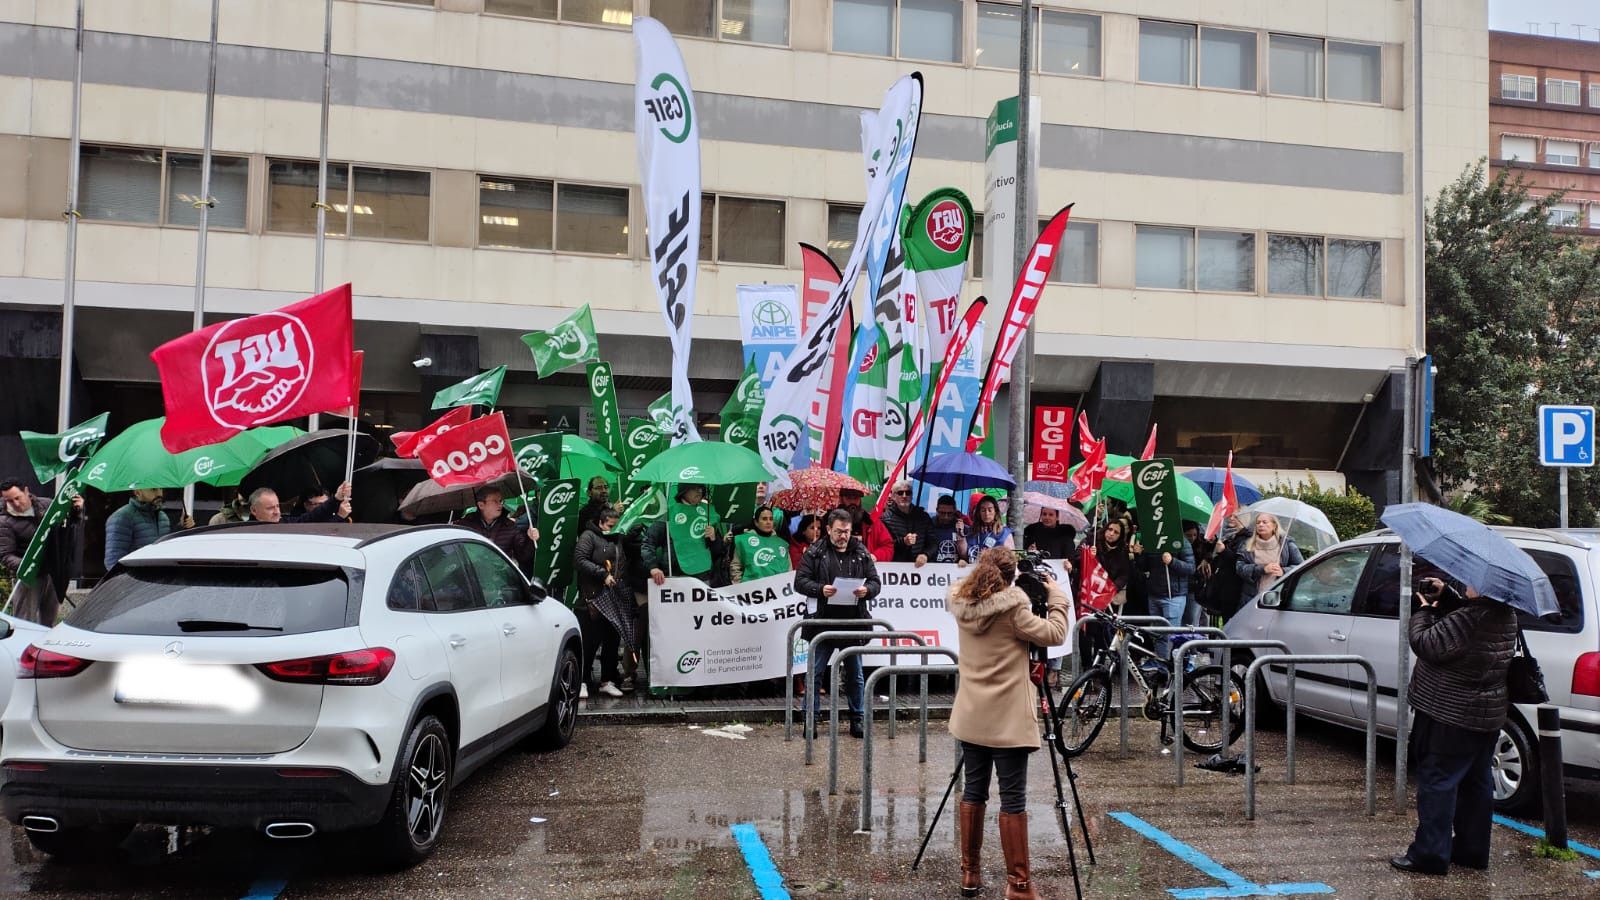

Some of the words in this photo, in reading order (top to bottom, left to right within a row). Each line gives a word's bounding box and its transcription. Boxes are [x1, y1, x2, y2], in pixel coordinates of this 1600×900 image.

[751, 325, 797, 338] ANPE
[852, 408, 882, 439] GT
[635, 431, 659, 443] CSIF
[1041, 410, 1065, 460] UGT
[1552, 412, 1586, 460] P
[519, 454, 549, 470] CSIF
[1143, 469, 1169, 482] CSIF
[549, 491, 576, 504] CSIF
[1152, 491, 1168, 550] CSIF
[548, 516, 566, 585] CSIF
[660, 589, 685, 603] En
[691, 587, 777, 606] DEENSA
[882, 572, 921, 586] IDAD
[693, 614, 704, 630] y
[711, 611, 735, 626] de
[741, 611, 769, 625] los
[706, 649, 732, 657] Central
[734, 646, 762, 655] Sindical
[706, 655, 757, 665] Independiente
[718, 663, 763, 673] Funcionarios
